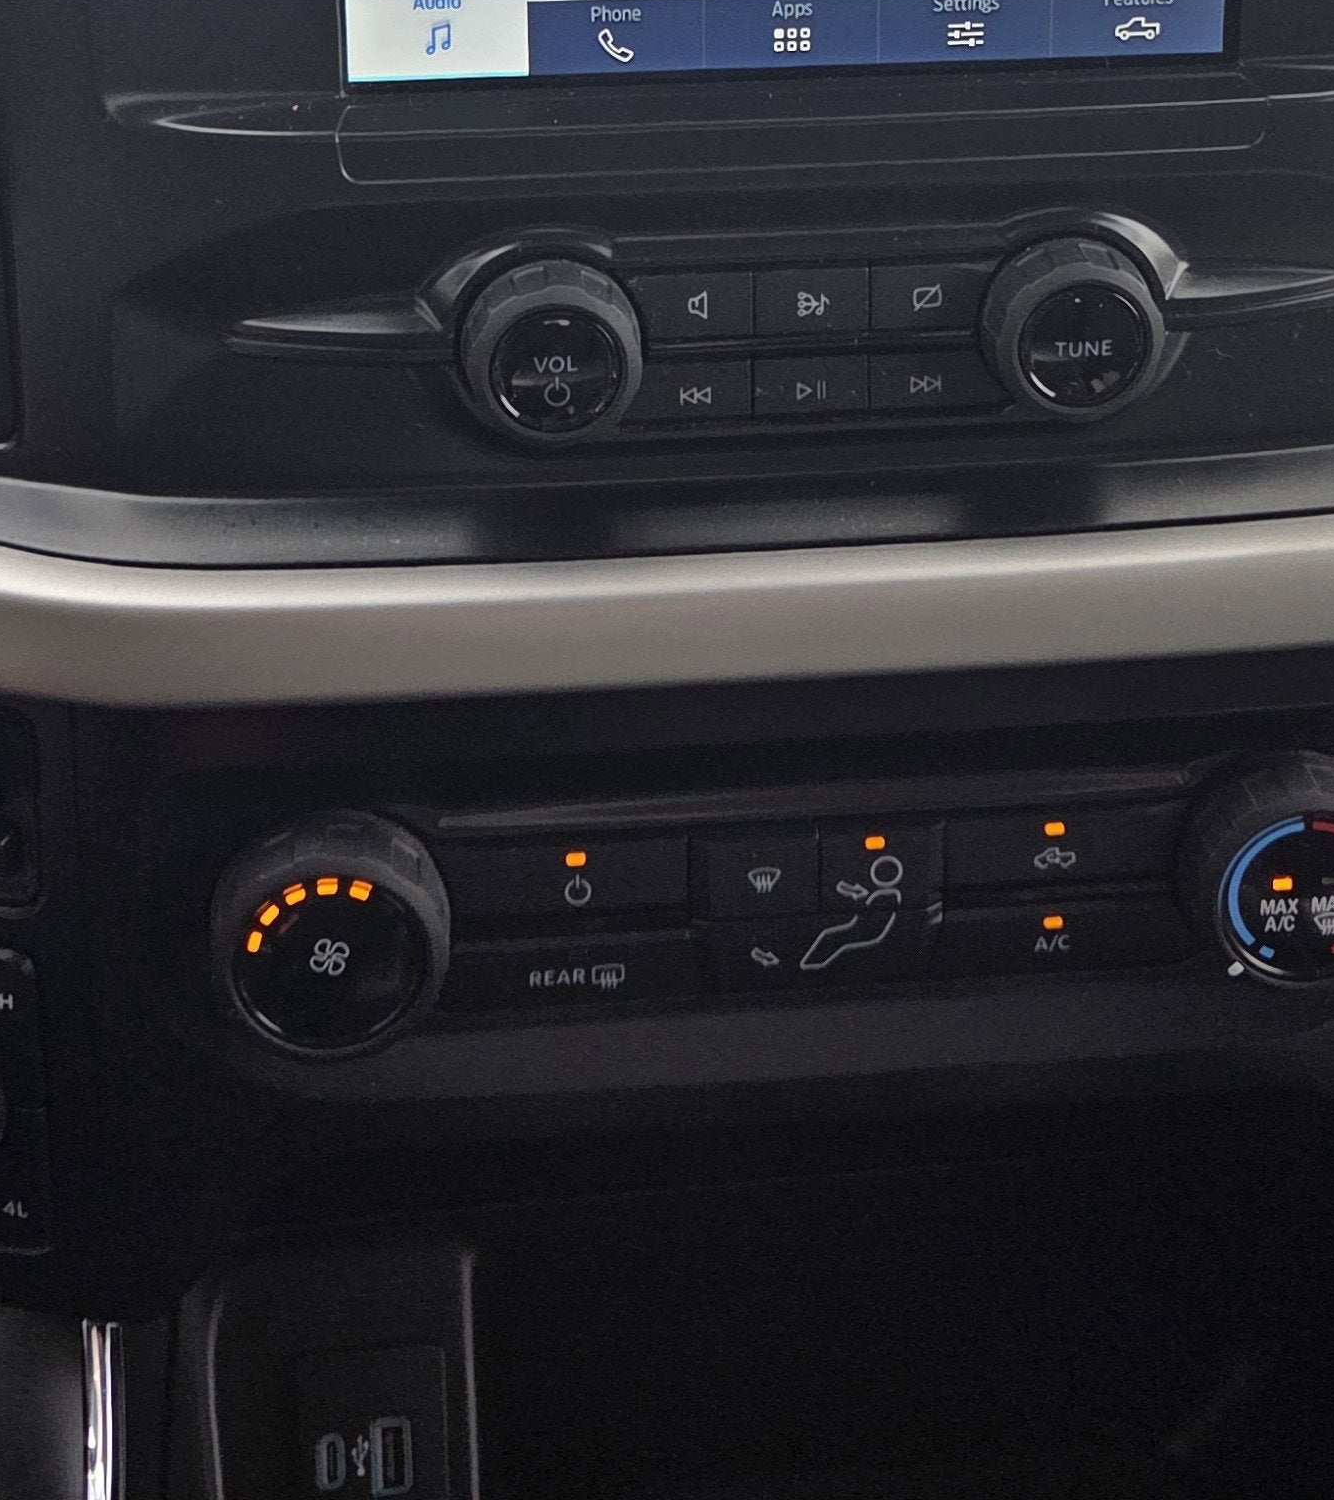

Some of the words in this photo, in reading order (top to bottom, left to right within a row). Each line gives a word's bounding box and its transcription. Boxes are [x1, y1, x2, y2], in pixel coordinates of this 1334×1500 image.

[590, 4, 642, 24] Phone
[771, 0, 813, 20] Apps
[1054, 339, 1113, 359] TUNE
[533, 355, 578, 375] VOL
[1260, 897, 1299, 916] MAX
[1264, 915, 1296, 933] A/C
[1034, 934, 1070, 954] A/C
[528, 968, 586, 987] REAR
[2, 1199, 28, 1219] 4L
